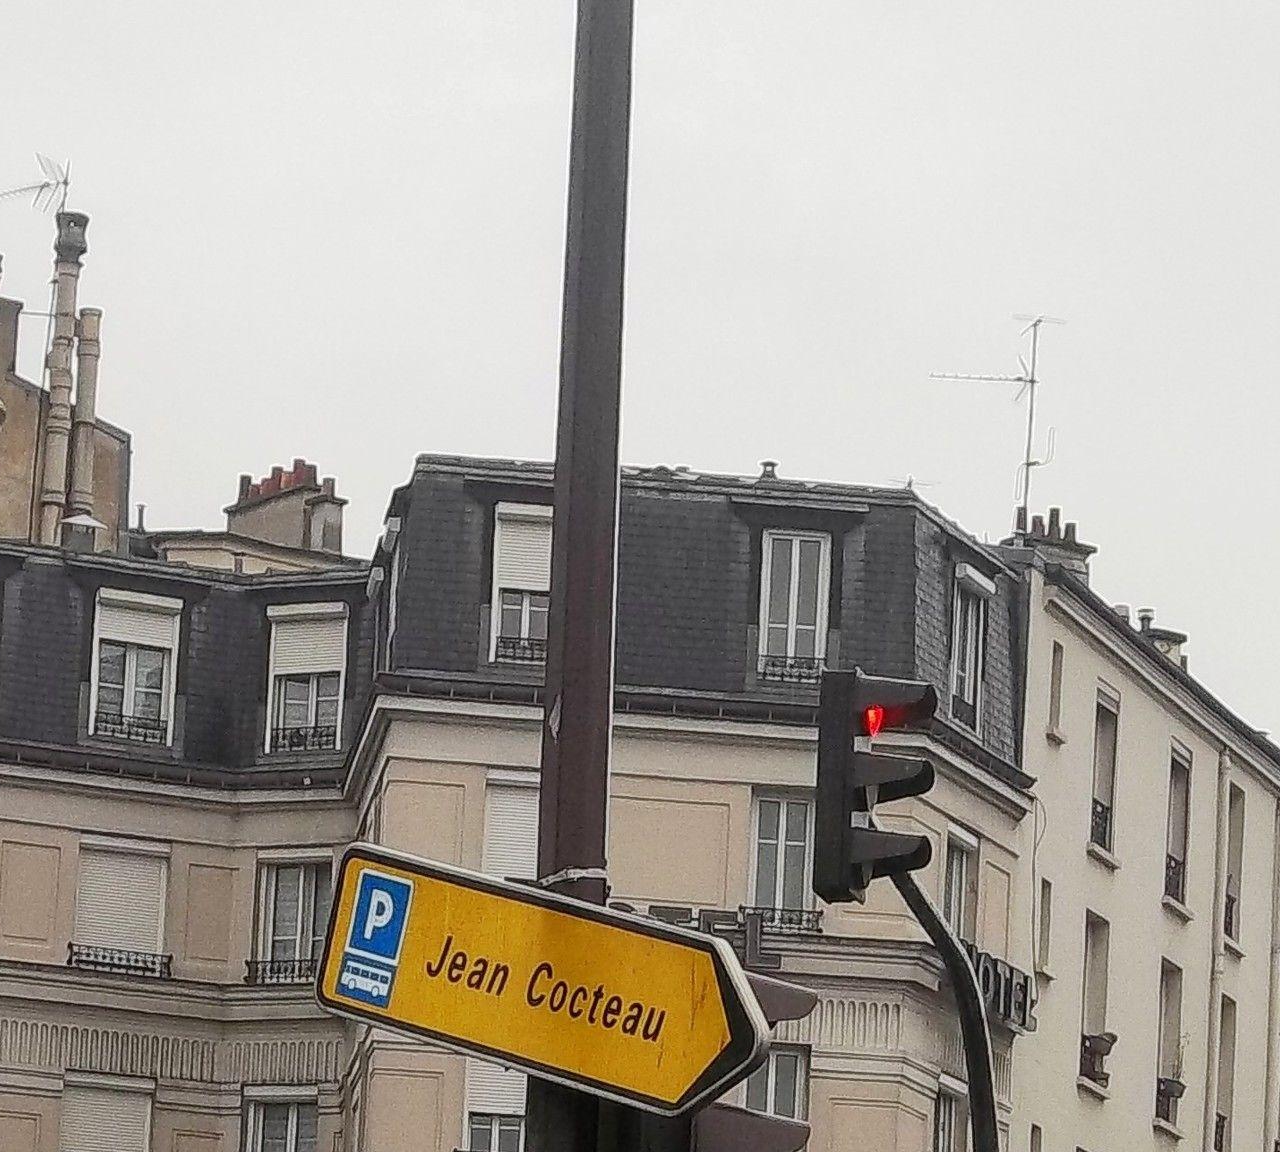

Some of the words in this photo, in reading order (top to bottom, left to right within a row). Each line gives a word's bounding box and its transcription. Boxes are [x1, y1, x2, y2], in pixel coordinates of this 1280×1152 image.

[364, 888, 394, 939] P
[425, 935, 509, 998] Jean
[525, 962, 666, 1043] Cocteau
